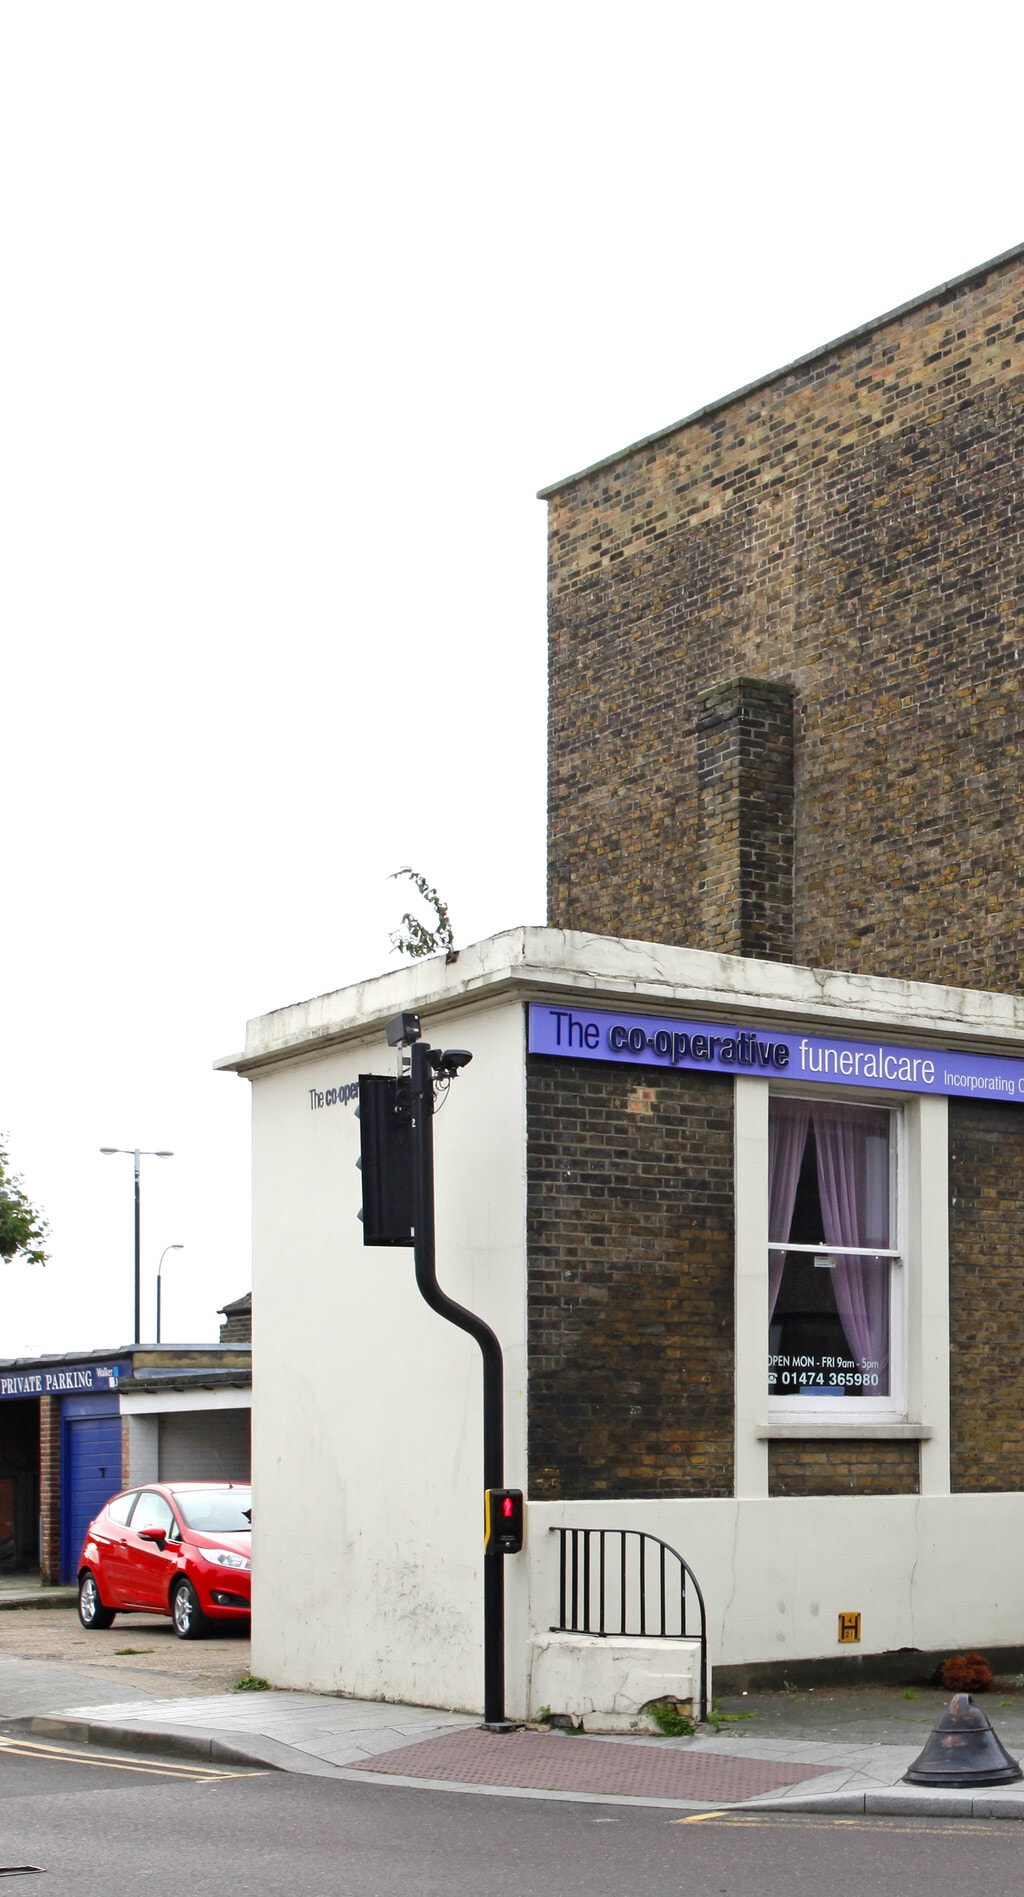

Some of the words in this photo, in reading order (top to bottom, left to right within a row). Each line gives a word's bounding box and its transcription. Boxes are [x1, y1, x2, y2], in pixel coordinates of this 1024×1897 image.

[550, 1011, 600, 1049] The
[609, 1024, 790, 1069] co-operative
[799, 1039, 935, 1084] funeralcare
[944, 1070, 1015, 1096] Incorporating
[309, 1088, 324, 1110] The
[792, 1356, 815, 1367] MON
[821, 1356, 835, 1368] FRI
[837, 1357, 855, 1369] 9am
[861, 1357, 879, 1372] 5pm
[1, 1375, 42, 1395] PRIVATE
[45, 1370, 93, 1391] PARKING
[781, 1371, 825, 1385] 01474
[829, 1372, 879, 1386] 365980
[841, 1615, 858, 1640] H
